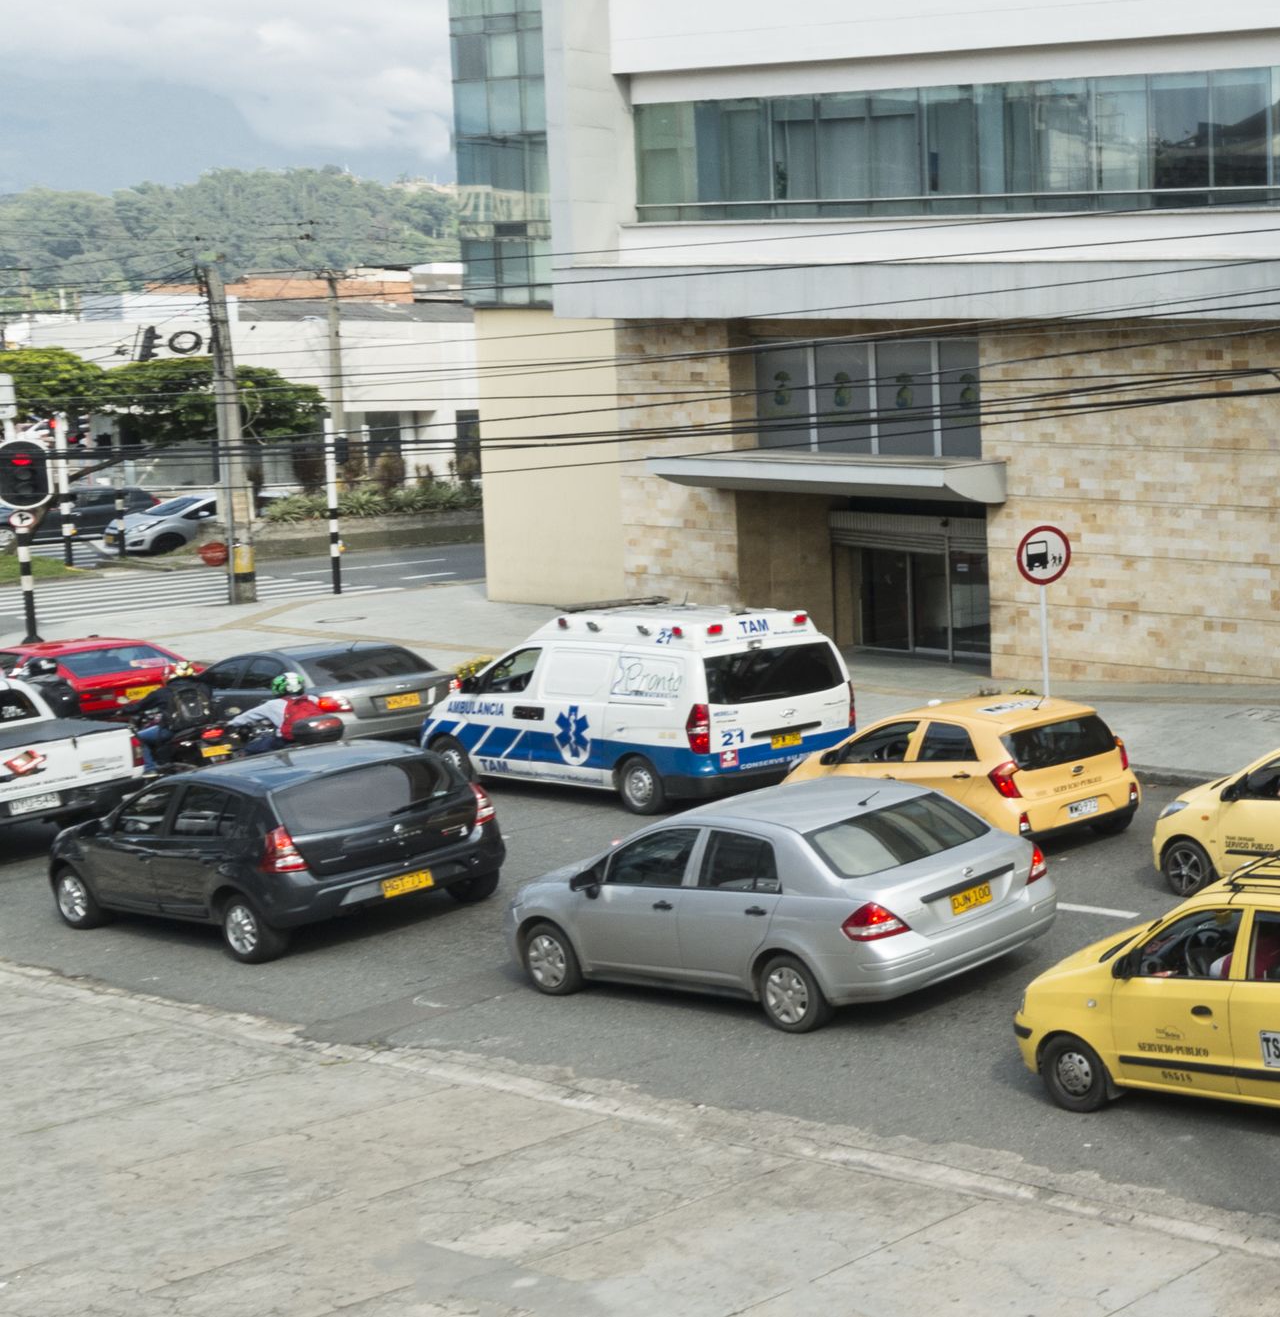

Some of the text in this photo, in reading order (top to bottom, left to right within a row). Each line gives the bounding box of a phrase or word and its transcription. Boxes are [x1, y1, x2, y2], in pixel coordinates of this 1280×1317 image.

[739, 619, 769, 634] TAM
[447, 700, 505, 716] AMBULANCIA
[722, 730, 745, 746] 21
